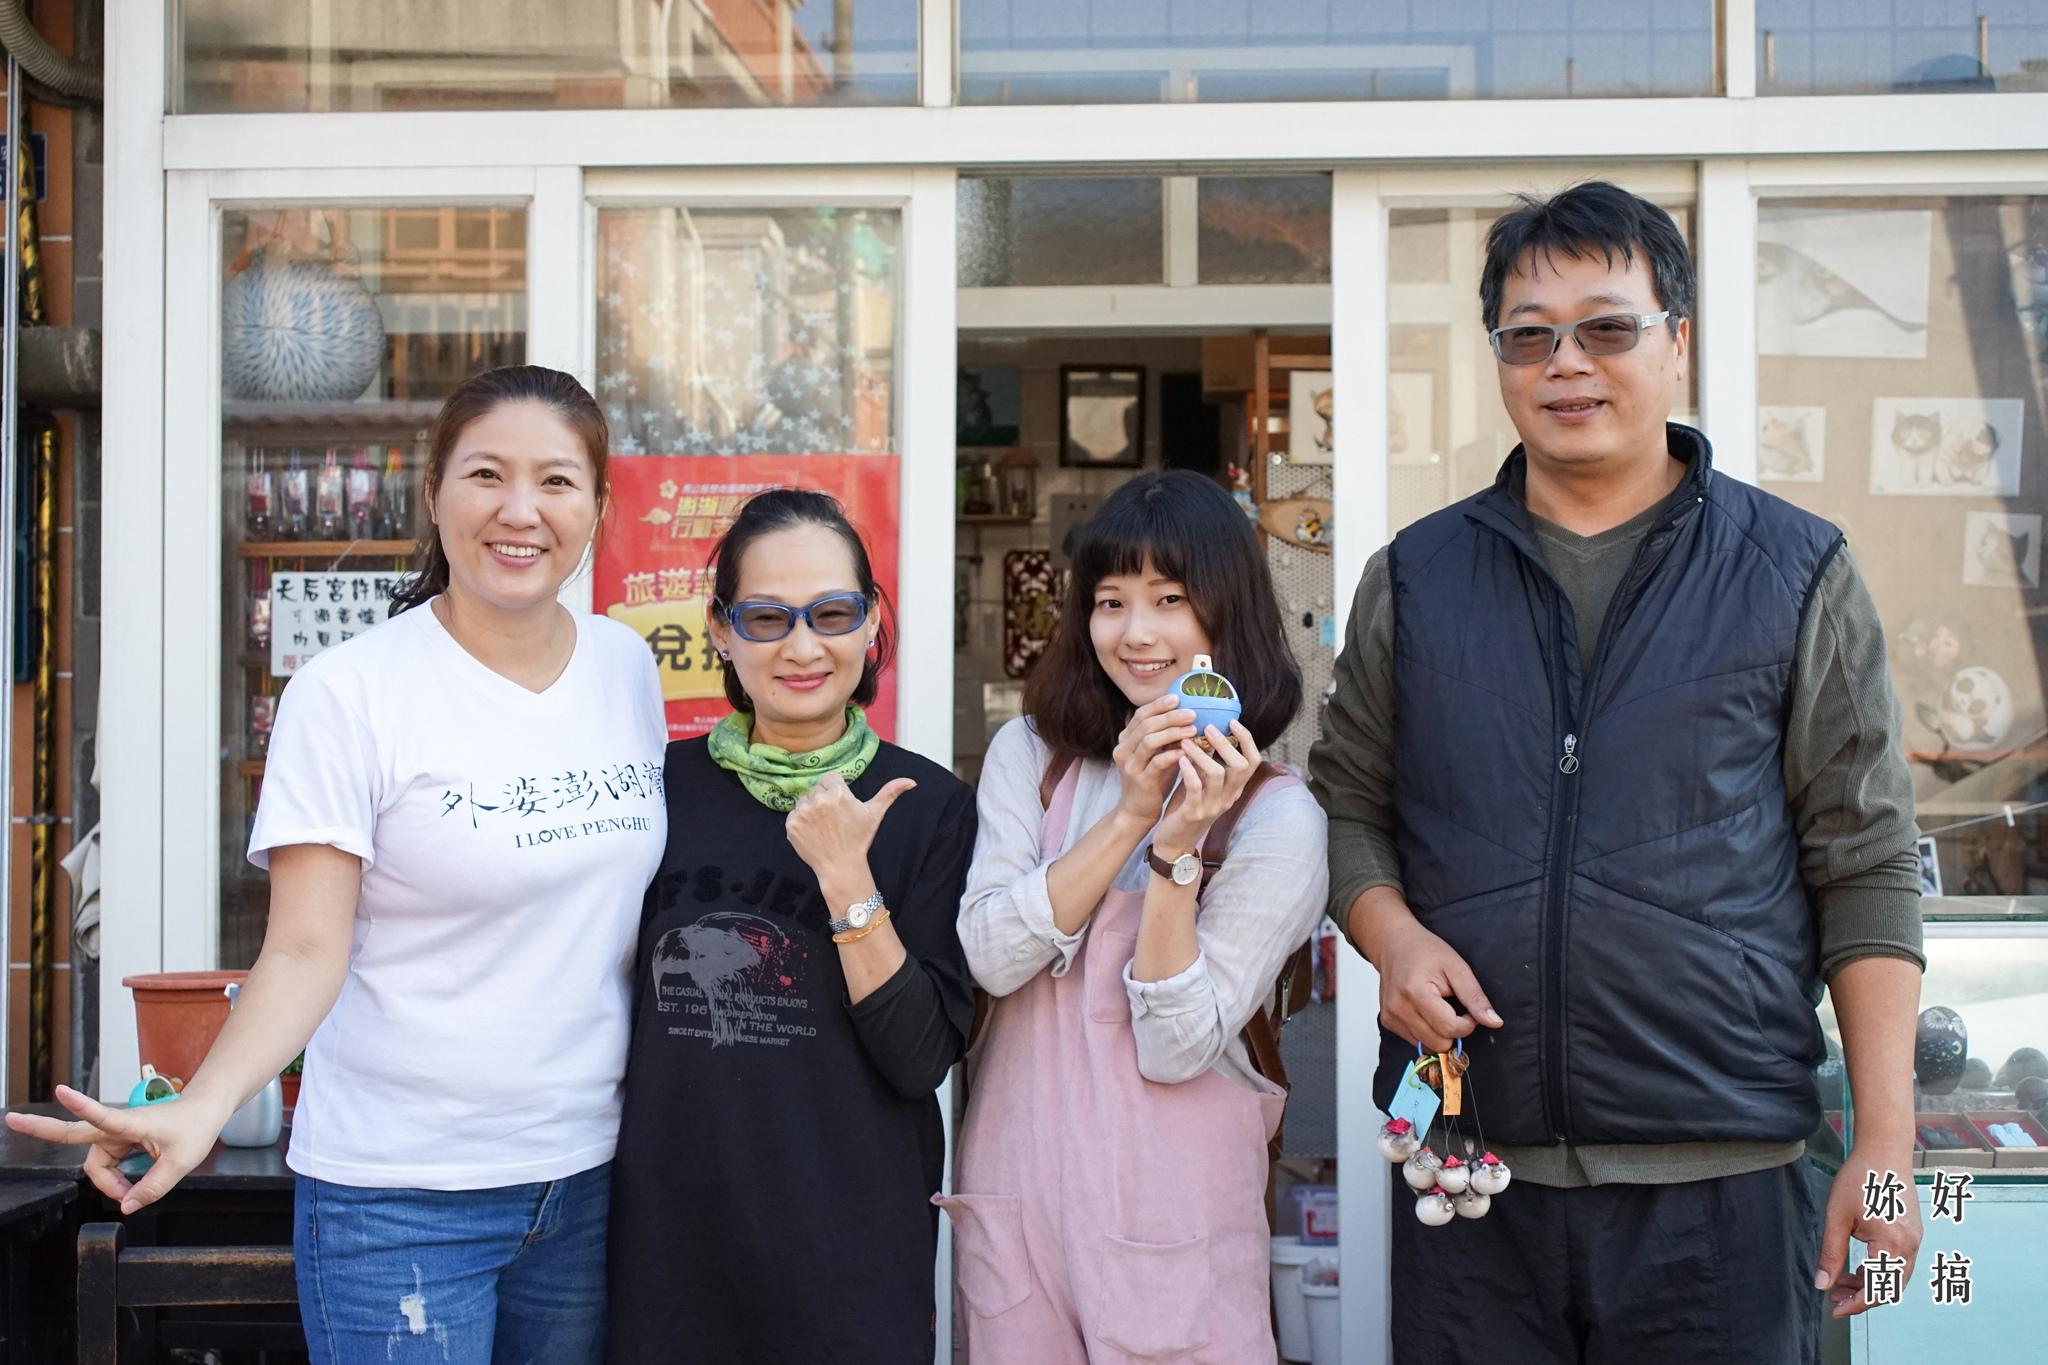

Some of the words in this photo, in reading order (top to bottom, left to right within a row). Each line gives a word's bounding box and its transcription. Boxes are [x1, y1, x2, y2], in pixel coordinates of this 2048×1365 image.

[276, 577, 415, 602] 天后宮許願
[514, 834, 522, 848] I
[528, 826, 577, 847] LOVE
[581, 816, 651, 836] PENGHU
[657, 1001, 680, 1013] EST.
[661, 986, 675, 996] THE
[675, 987, 703, 999] CASUAL
[777, 997, 808, 1009] ENJOYS
[749, 1021, 773, 1033] THE
[776, 1024, 817, 1037] WORLD
[759, 1036, 791, 1047] MARKET
